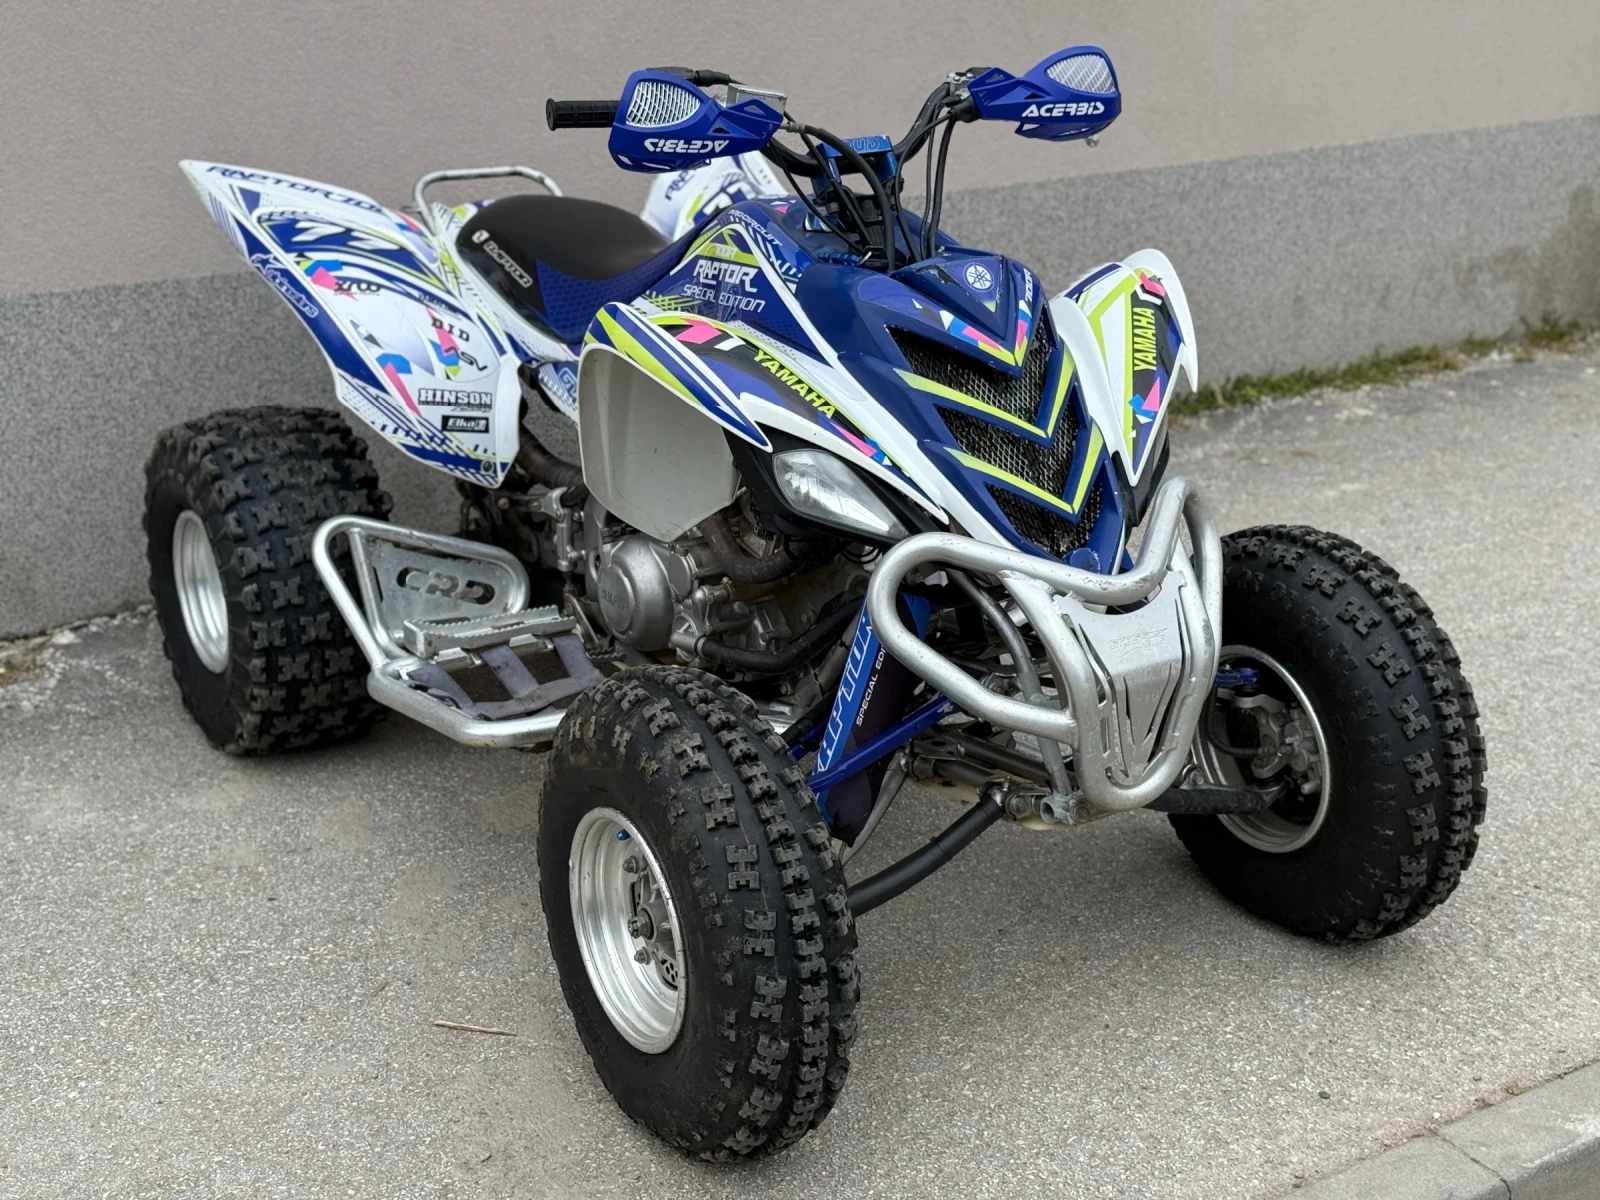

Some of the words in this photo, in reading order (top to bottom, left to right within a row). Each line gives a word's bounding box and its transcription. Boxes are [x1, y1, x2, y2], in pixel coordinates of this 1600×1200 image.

[1021, 101, 1105, 118] ACERBIS
[643, 138, 729, 154] ACERBIS
[741, 211, 783, 247] CIRCUIT
[692, 259, 759, 293] RAPTOR
[718, 292, 766, 313] EDITION
[1132, 306, 1157, 371] YAMAHA
[417, 388, 493, 405] HINSON
[753, 349, 838, 419] YAMAHA
[447, 417, 476, 428] Elka
[855, 674, 879, 727] SPECIAL
